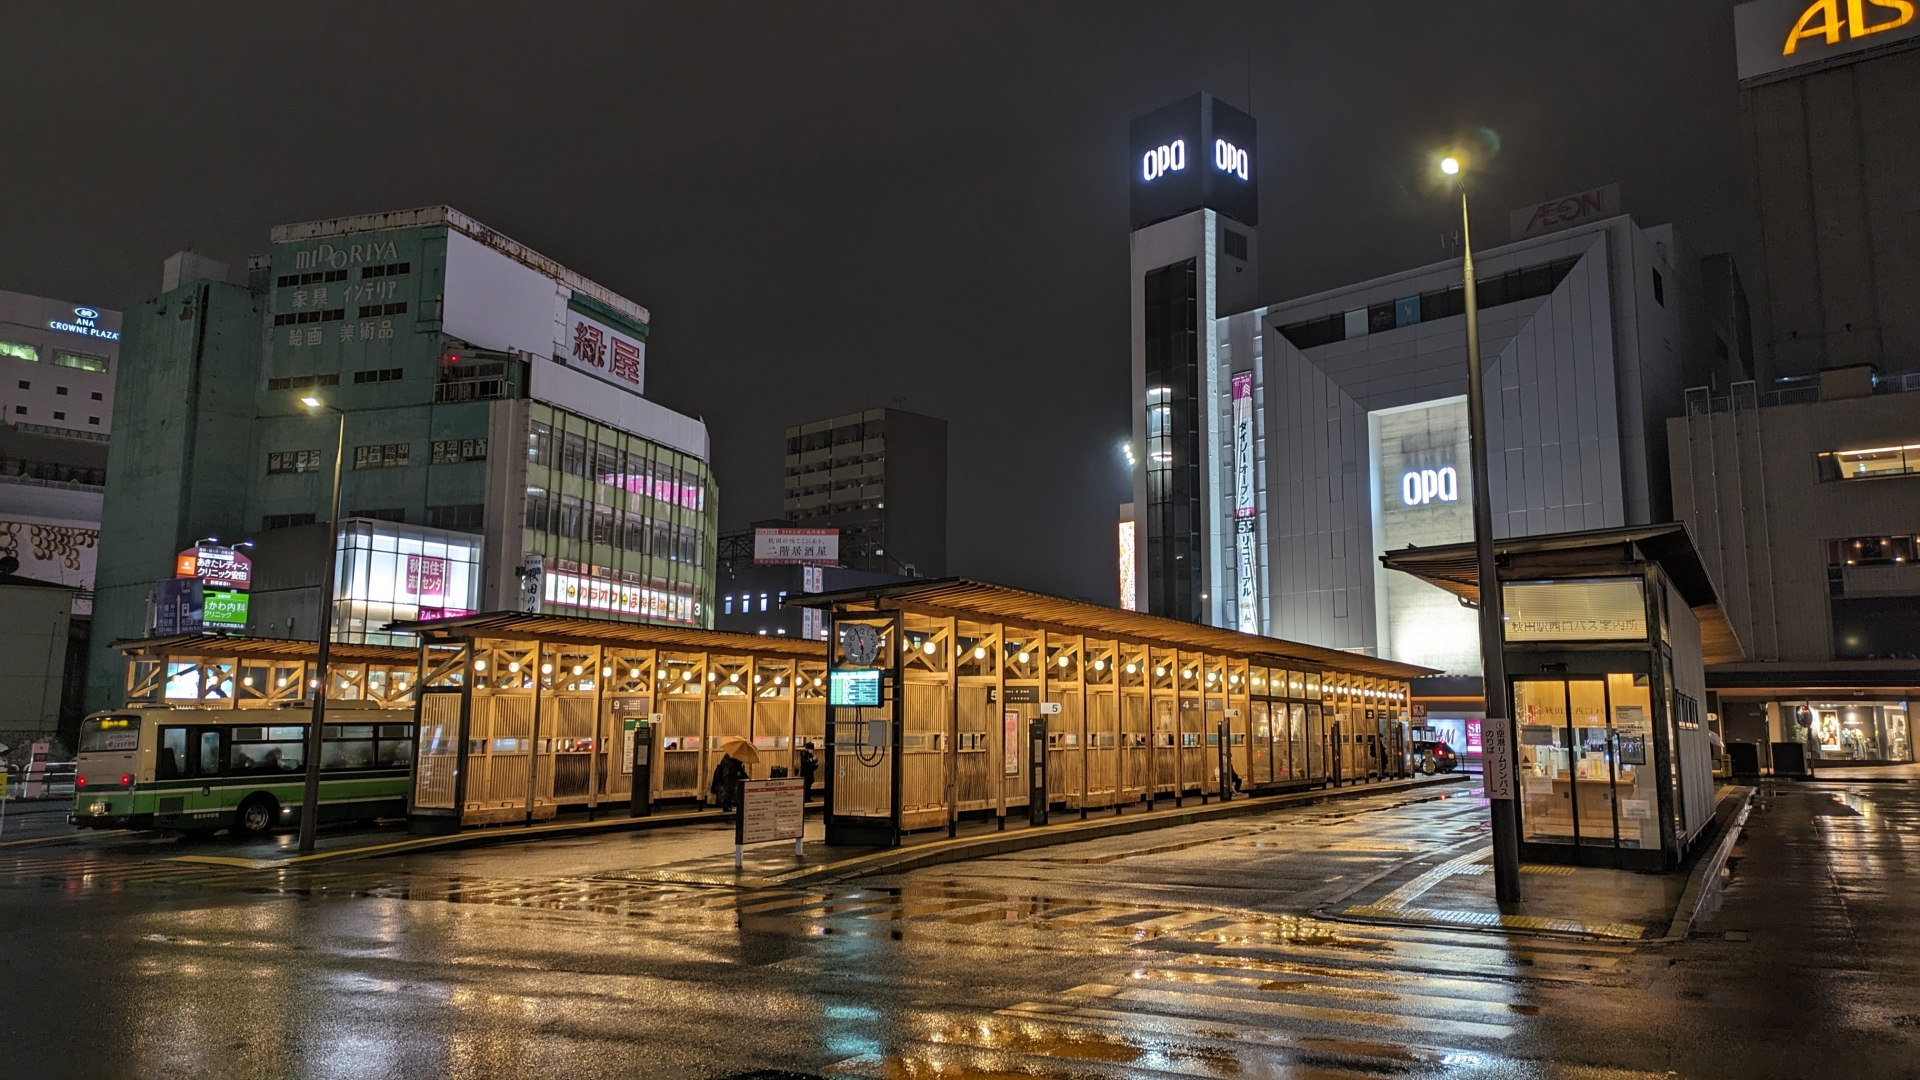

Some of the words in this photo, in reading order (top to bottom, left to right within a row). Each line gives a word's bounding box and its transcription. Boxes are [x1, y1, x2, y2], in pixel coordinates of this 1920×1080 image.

[292, 287, 328, 308] 家具
[343, 281, 397, 303] インテリア
[76, 317, 95, 328] ANA
[50, 320, 88, 335] CROWNE
[90, 328, 119, 340] PLAZA
[288, 326, 323, 347] 絵画
[340, 319, 394, 343] 美術品
[572, 320, 640, 385] 緑屋
[766, 545, 827, 557] 二階居酒屋
[197, 558, 249, 570] あきたレディース
[1242, 533, 1251, 598] リニューアル
[197, 568, 247, 580] クリニック安田
[1511, 619, 1639, 633] 秋田駅西口バス案内所
[613, 700, 620, 710] 9
[1051, 704, 1059, 713] 5
[1182, 700, 1190, 709] 4
[656, 714, 661, 722] 9
[1485, 730, 1495, 755] のりば
